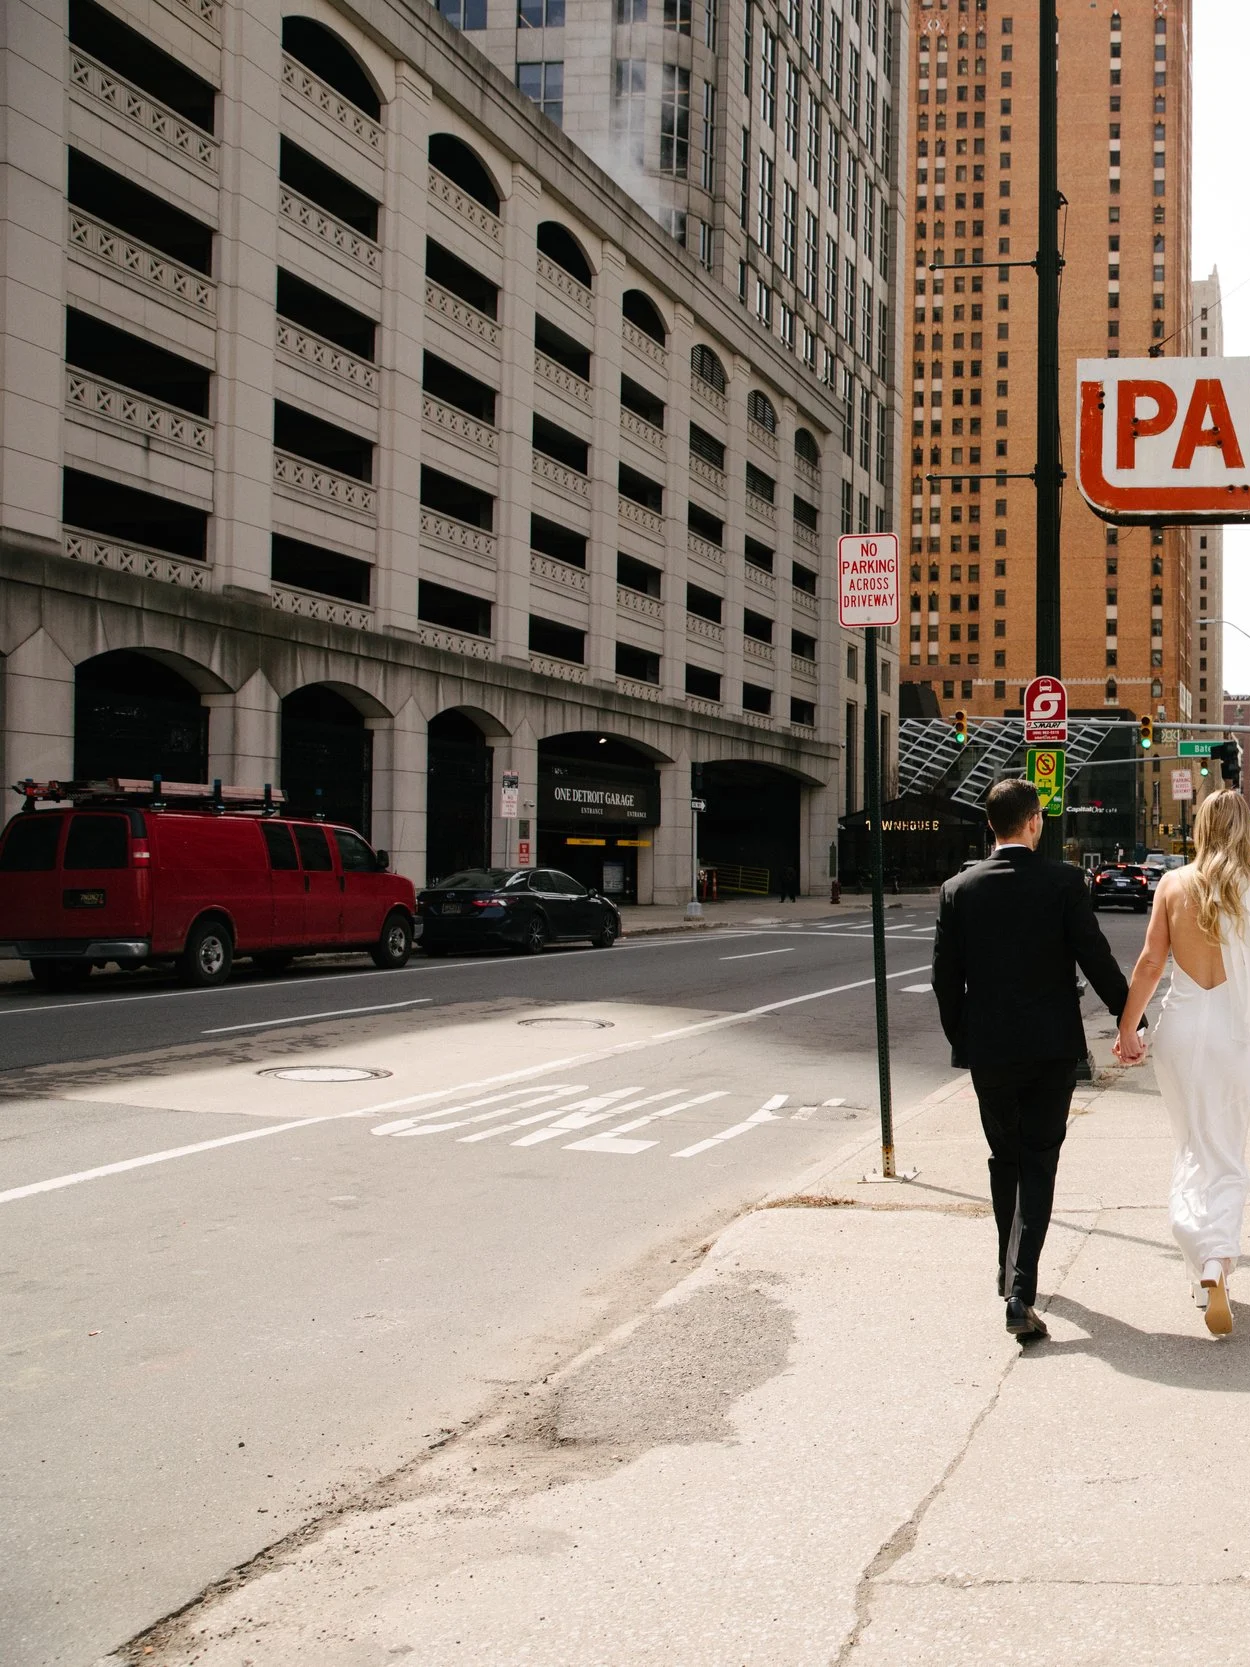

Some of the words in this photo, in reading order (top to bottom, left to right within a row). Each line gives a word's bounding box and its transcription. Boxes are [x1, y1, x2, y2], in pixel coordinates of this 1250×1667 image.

[861, 543, 877, 557] NO
[843, 559, 895, 575] PARKING
[849, 577, 889, 591] ACROSS
[844, 593, 895, 608] DRIVEWAY
[1031, 721, 1066, 729] SMART
[554, 787, 571, 801] ONE
[572, 788, 604, 804] DETROIT
[605, 792, 634, 807] GARAGE
[581, 807, 604, 815] ENTRANCE
[627, 811, 647, 819] ENTRANCE
